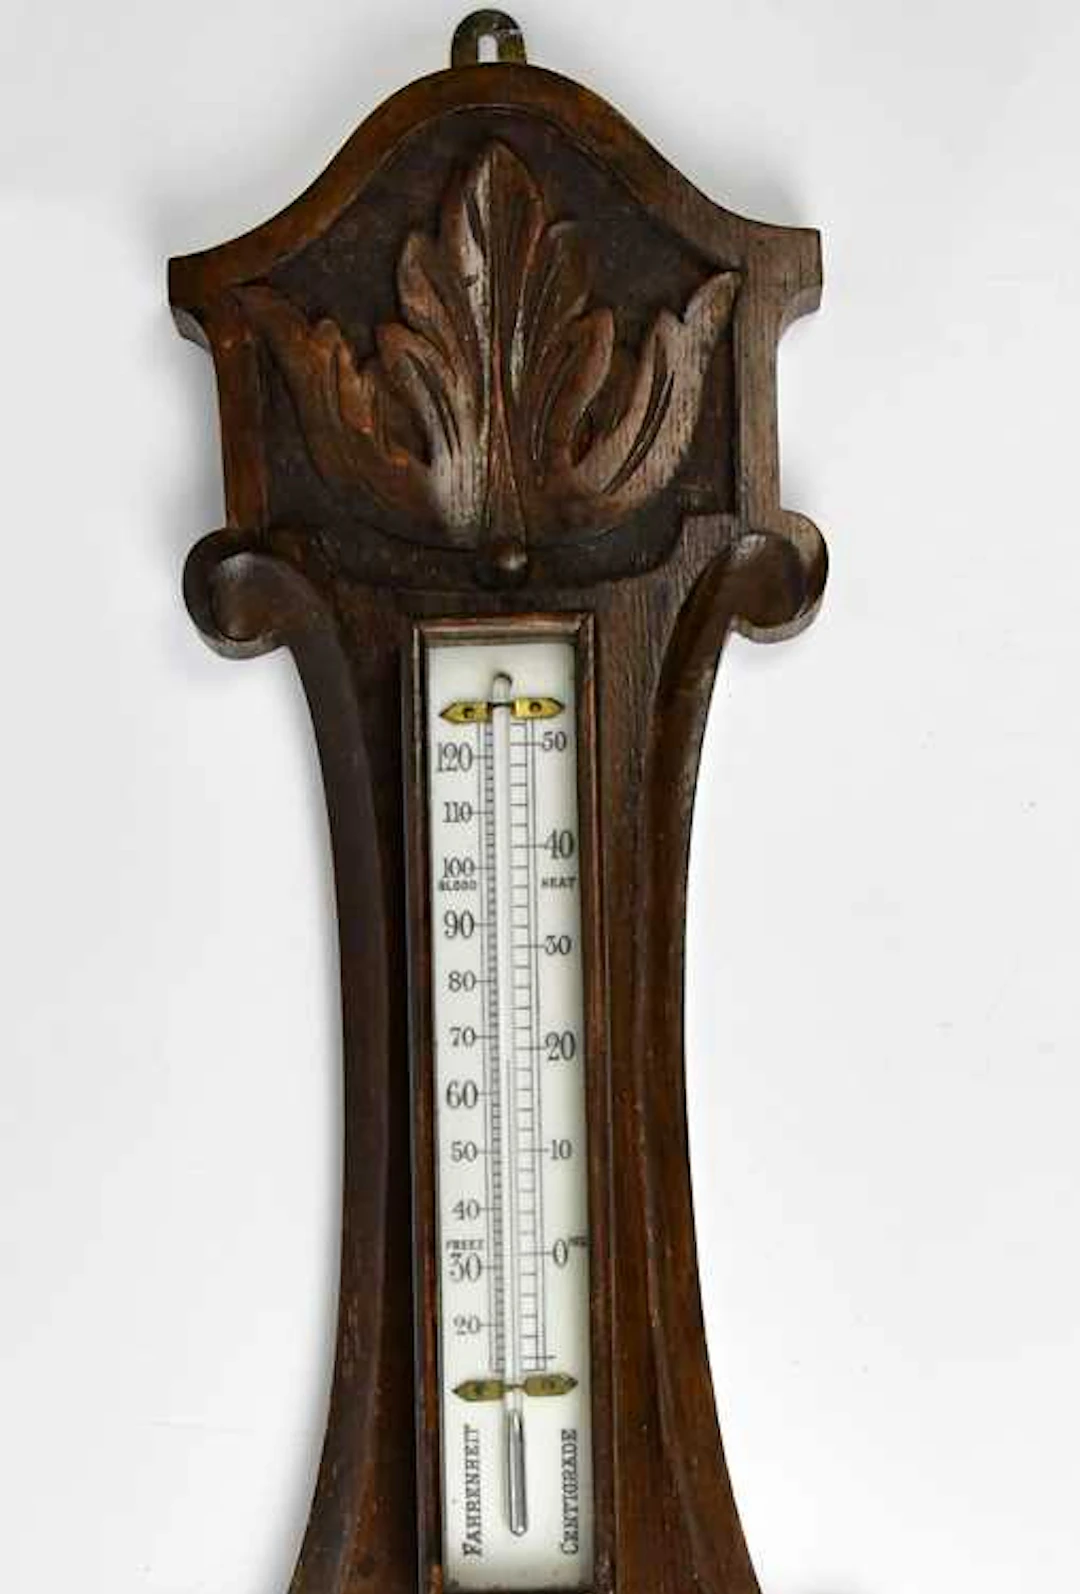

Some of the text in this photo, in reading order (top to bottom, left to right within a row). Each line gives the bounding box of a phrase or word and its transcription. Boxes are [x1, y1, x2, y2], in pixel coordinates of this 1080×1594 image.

[542, 731, 567, 752] 50
[437, 743, 473, 772] 120
[443, 802, 472, 823] 110
[545, 830, 575, 860] 40
[443, 857, 475, 878] 100
[438, 880, 477, 891] BLOOD
[541, 876, 577, 889] HEAT
[444, 910, 475, 939] 90
[545, 935, 572, 955] 30
[448, 970, 476, 992] 80
[450, 1026, 476, 1047] 70
[545, 1031, 576, 1062] 20
[446, 1080, 478, 1109] 60
[451, 1141, 477, 1162] 50
[551, 1139, 573, 1160] 10
[452, 1199, 480, 1221] 40
[449, 1252, 481, 1282] 30
[453, 1315, 480, 1335] 20
[462, 1423, 483, 1557] FAHRENHEIT
[560, 1429, 579, 1555] CENTIGRADE
